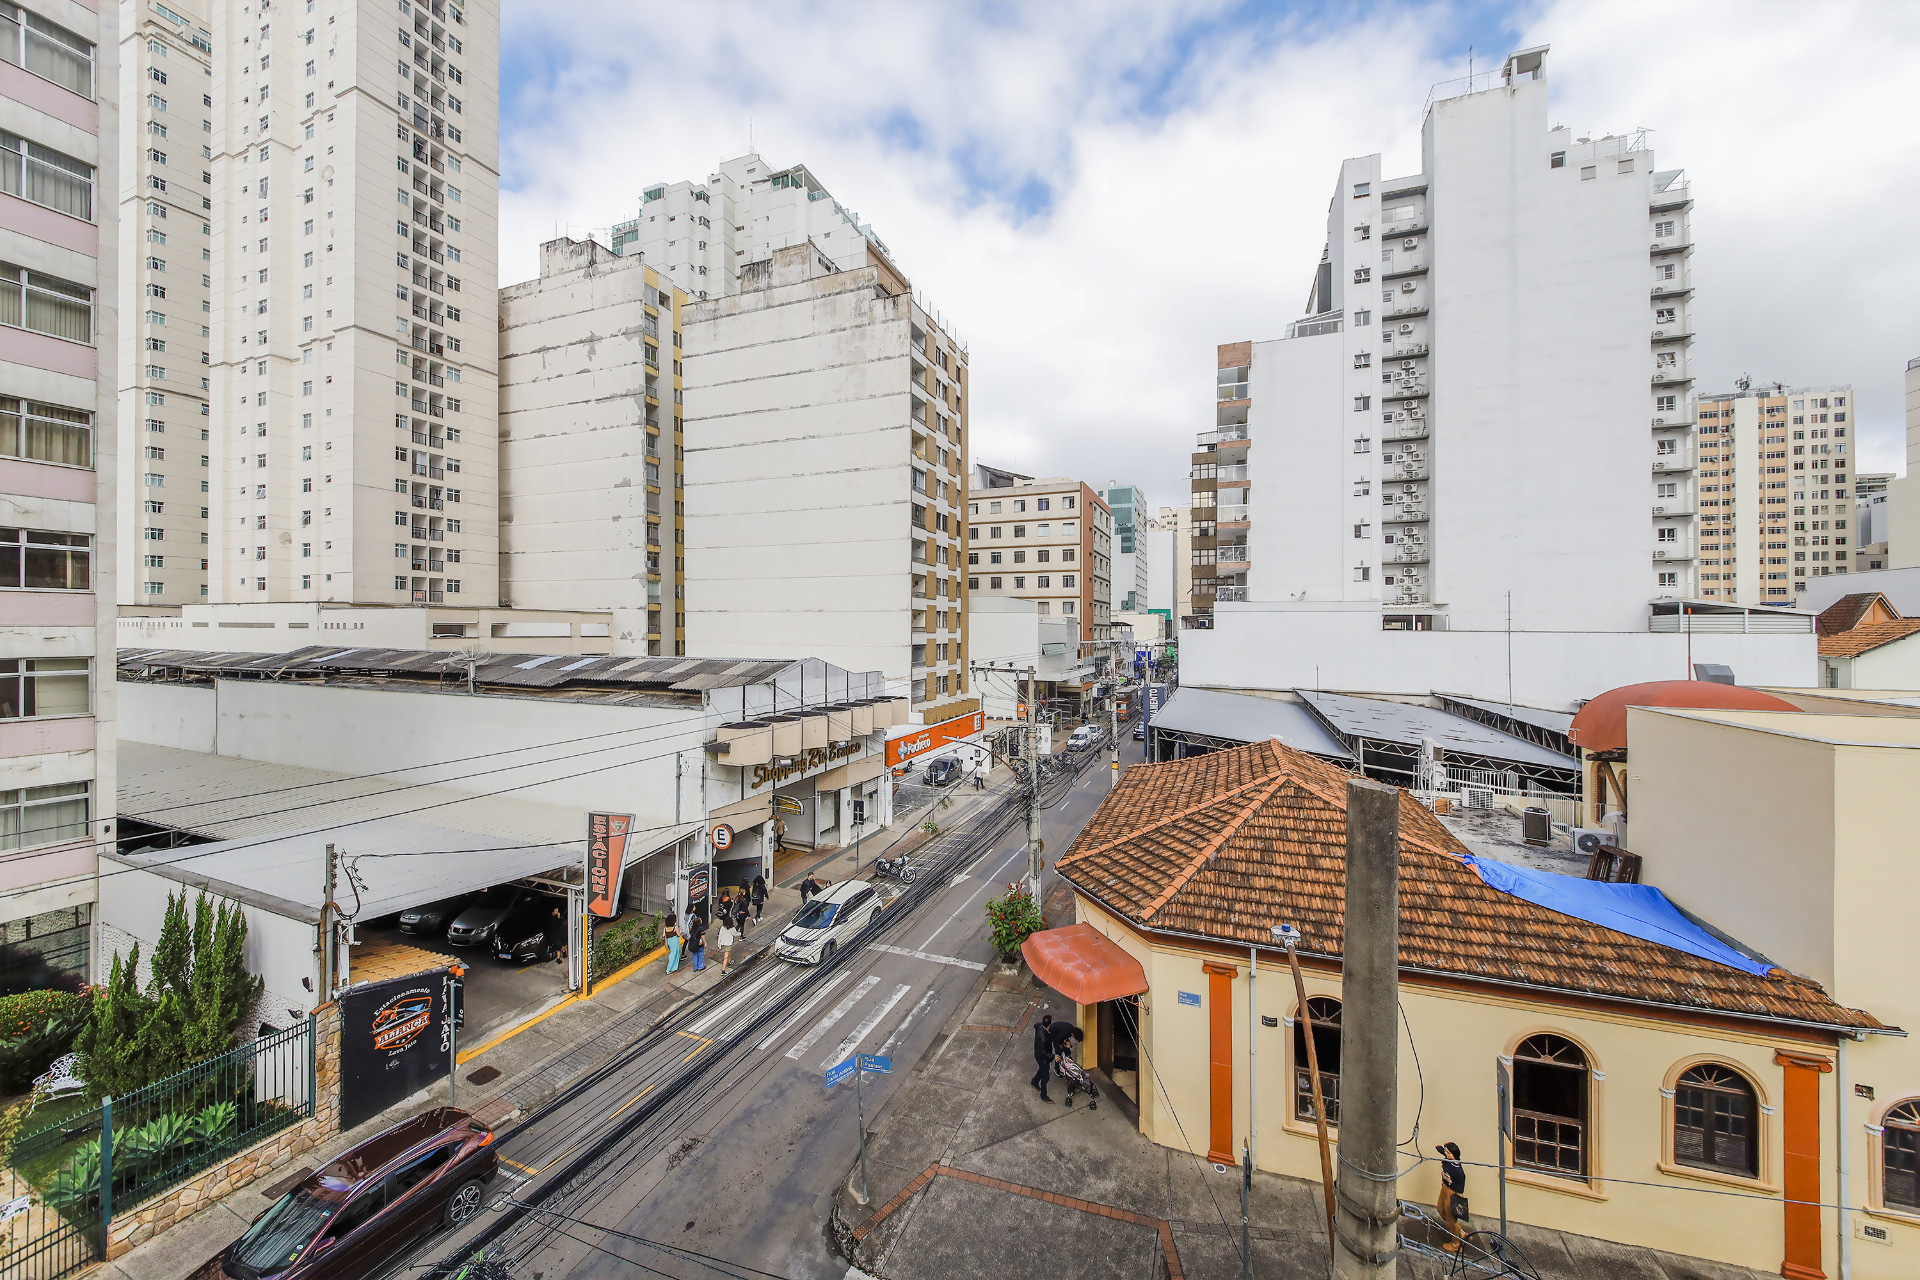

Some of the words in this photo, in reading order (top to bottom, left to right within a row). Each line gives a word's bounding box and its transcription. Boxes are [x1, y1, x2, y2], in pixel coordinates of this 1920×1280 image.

[907, 739, 931, 755] Pacheco
[752, 758, 808, 789] Shopping
[808, 748, 828, 770] Rio
[829, 741, 861, 761] Branco
[717, 829, 725, 840] E
[592, 815, 607, 894] ESTACIONE
[374, 988, 430, 1016] Estacionamento
[440, 1015, 450, 1052] JATO
[387, 1046, 404, 1057] Lava
[404, 1039, 417, 1052] Jato
[826, 1070, 836, 1078] Rua
